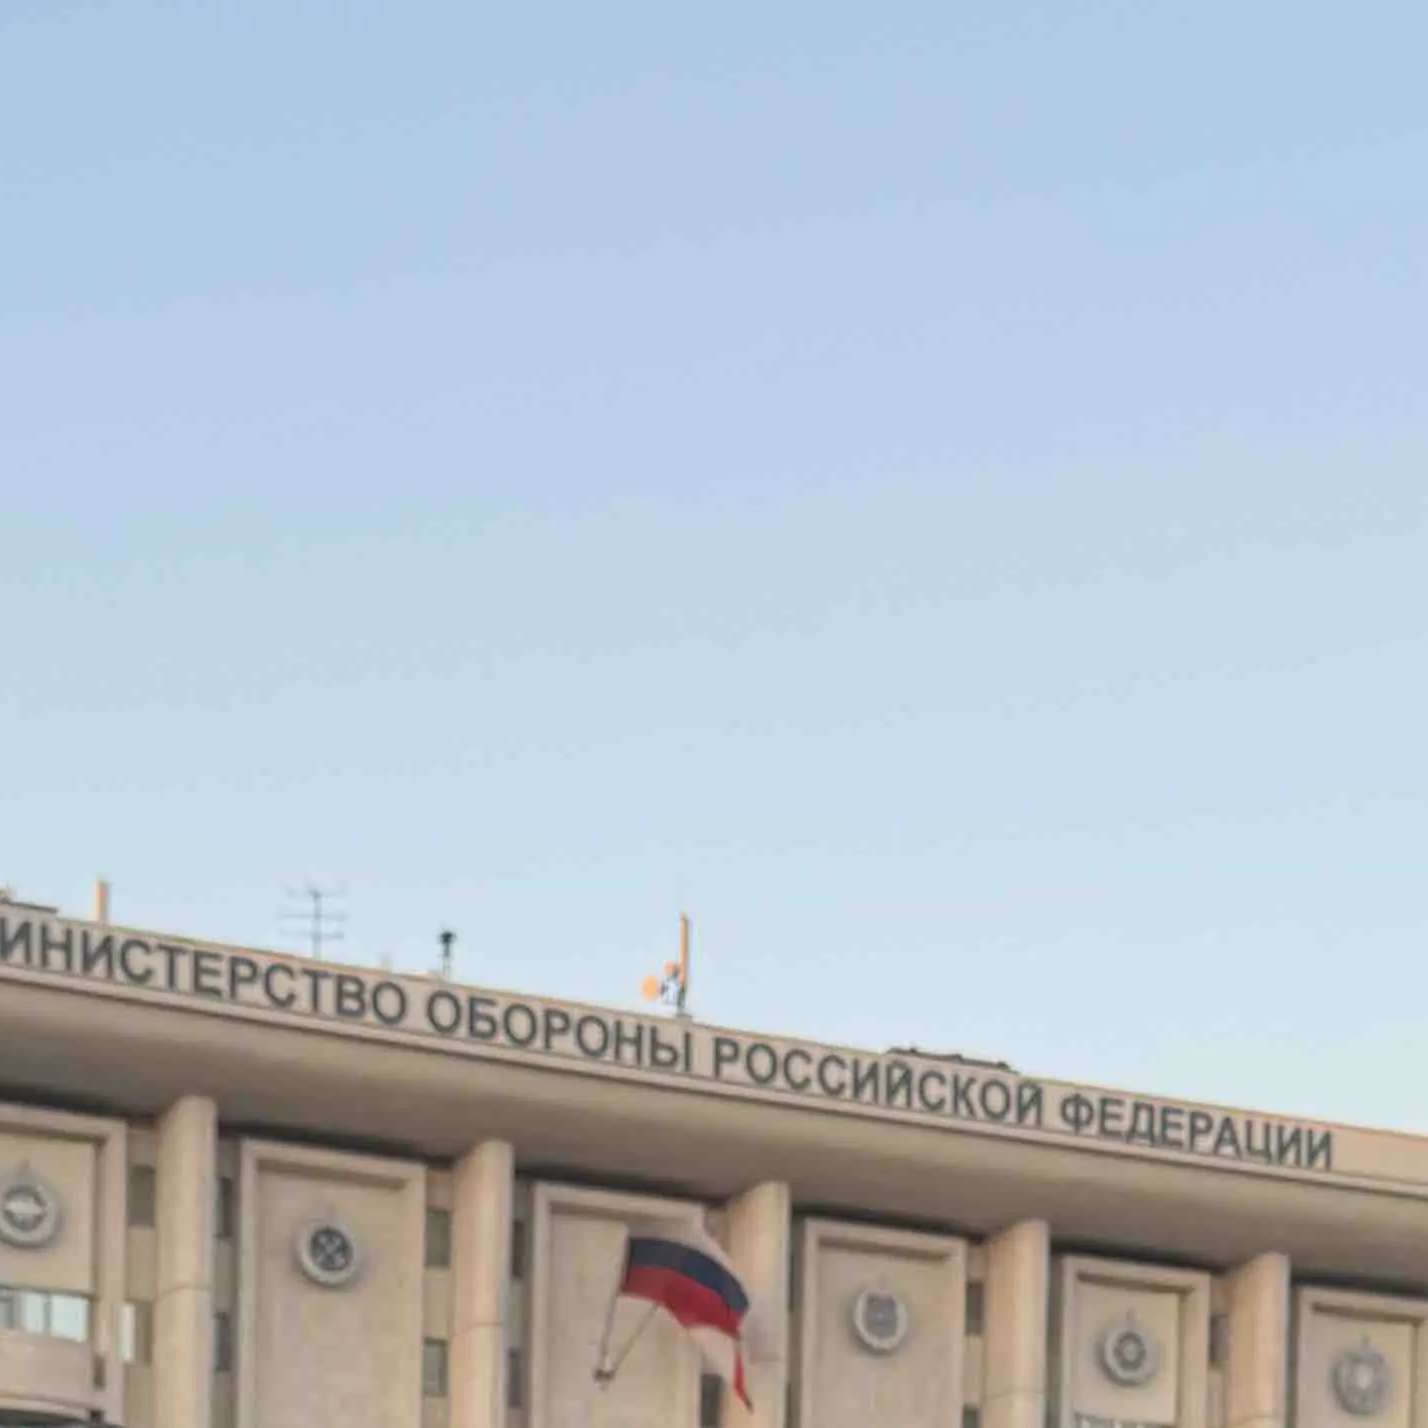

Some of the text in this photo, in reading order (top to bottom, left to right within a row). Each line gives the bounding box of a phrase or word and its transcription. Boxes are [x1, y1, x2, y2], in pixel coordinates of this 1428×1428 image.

[427, 990, 693, 1073] ОБОРОНЫ
[713, 1037, 1044, 1127] РОССИЙСКОЙ
[1060, 1093, 1333, 1170] ФЕДЕРАЦИИ
